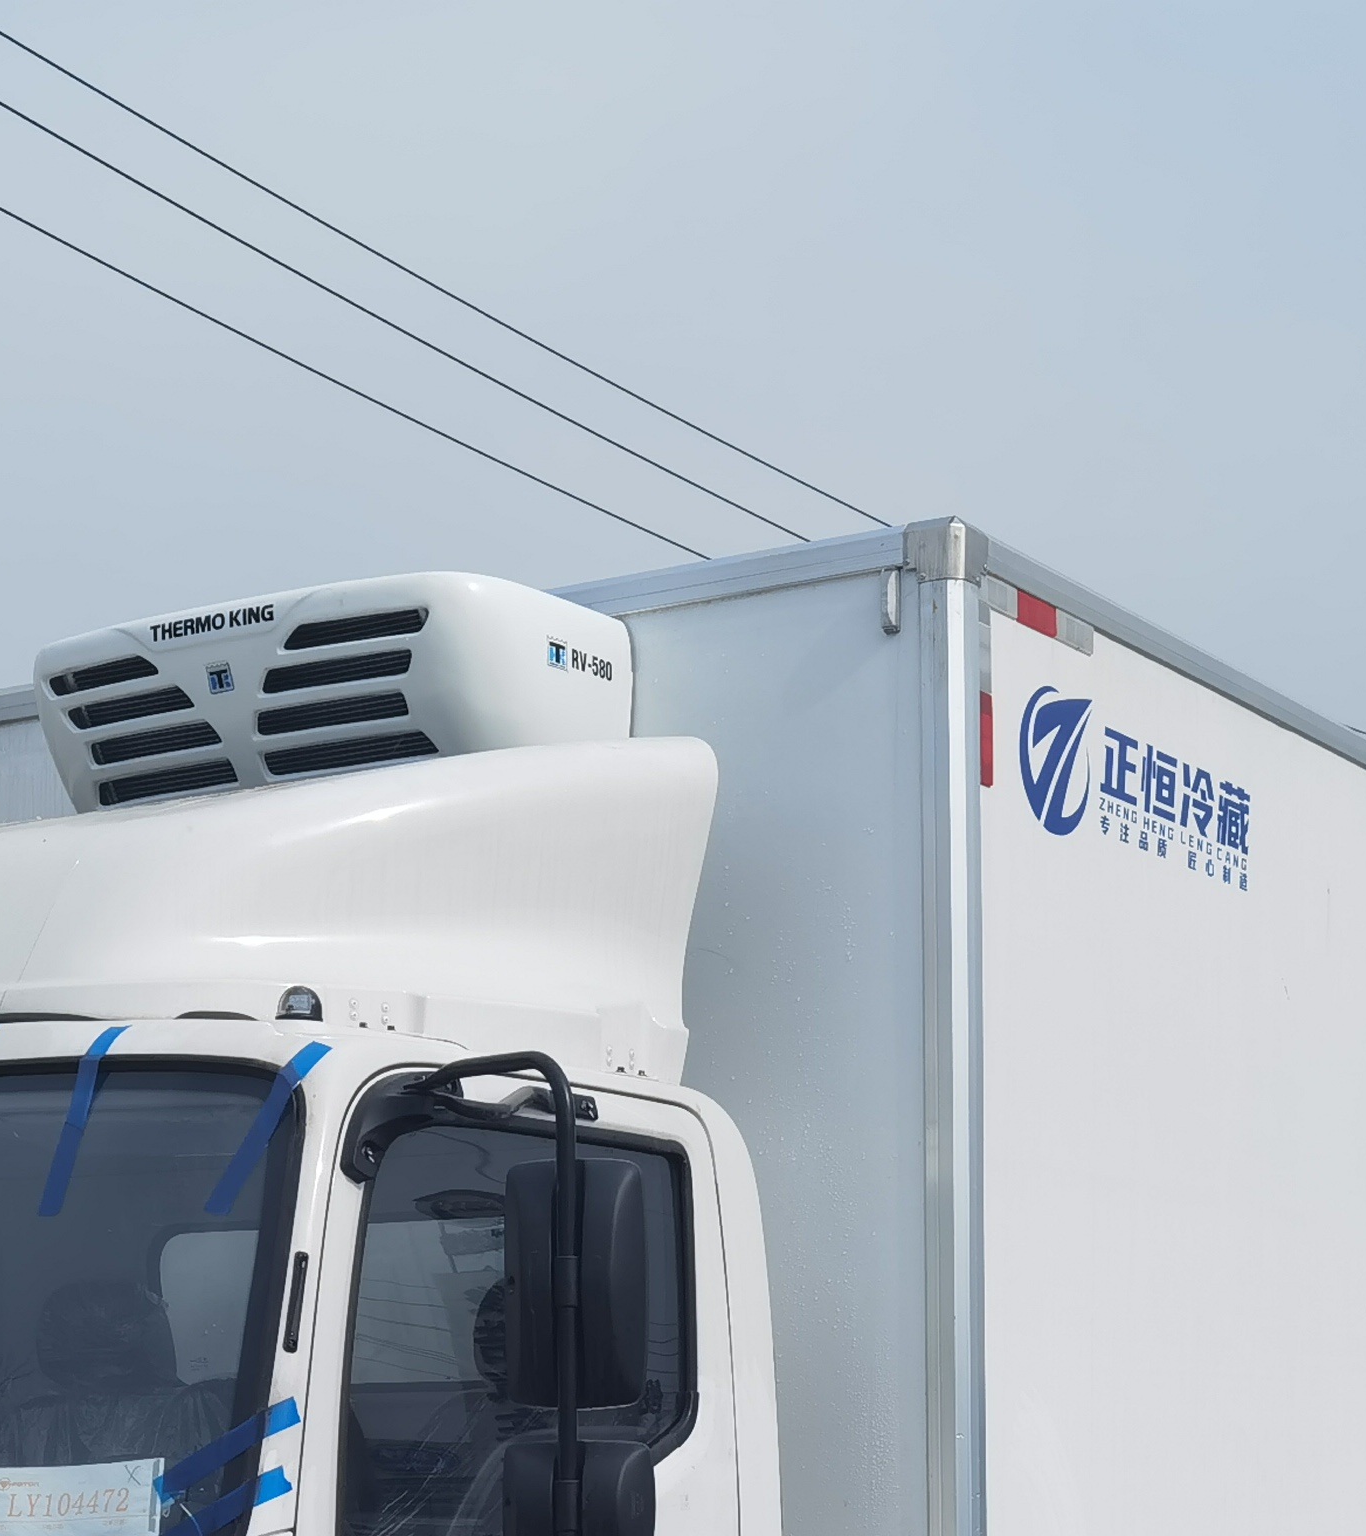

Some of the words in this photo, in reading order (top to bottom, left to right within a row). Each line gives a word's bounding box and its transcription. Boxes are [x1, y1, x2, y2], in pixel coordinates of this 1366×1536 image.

[150, 613, 226, 642] THERMO
[229, 604, 275, 628] KING
[571, 648, 613, 681] RV-580
[1100, 726, 1250, 855] 正恒冷藏
[1099, 797, 1138, 824] ZHENG
[1143, 816, 1174, 841] HENG
[1180, 832, 1213, 855] LENG
[1216, 847, 1248, 871] CANG
[1099, 815, 1167, 859] 专注品质
[1187, 850, 1248, 891] 匠心制造
[7, 1487, 130, 1518] LY104472
